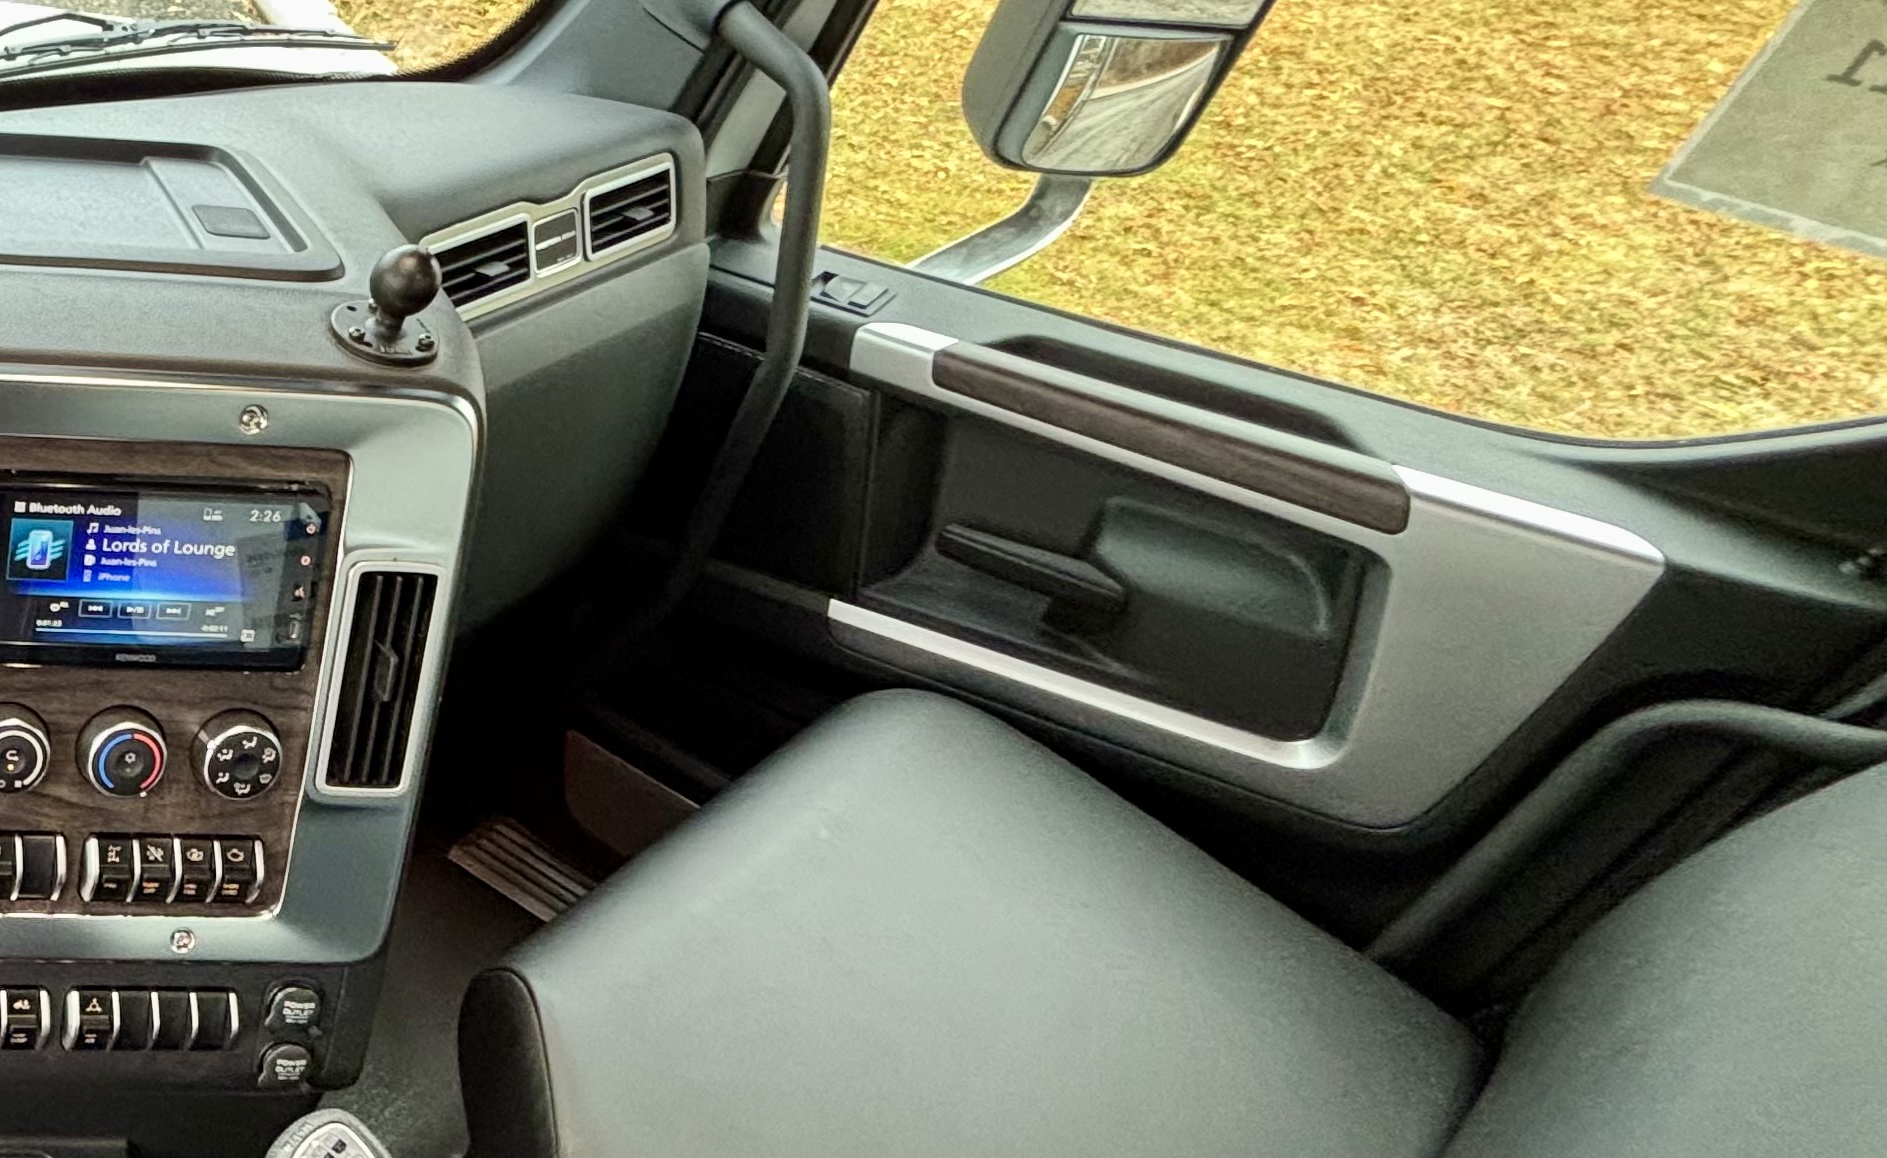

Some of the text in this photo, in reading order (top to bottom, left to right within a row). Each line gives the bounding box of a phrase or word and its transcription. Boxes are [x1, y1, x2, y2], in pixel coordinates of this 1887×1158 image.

[29, 502, 122, 516] Bluetooth Audio
[249, 509, 282, 523] 2:26
[102, 538, 236, 559] Lords of Lounge
[284, 1001, 315, 1009] POWER
